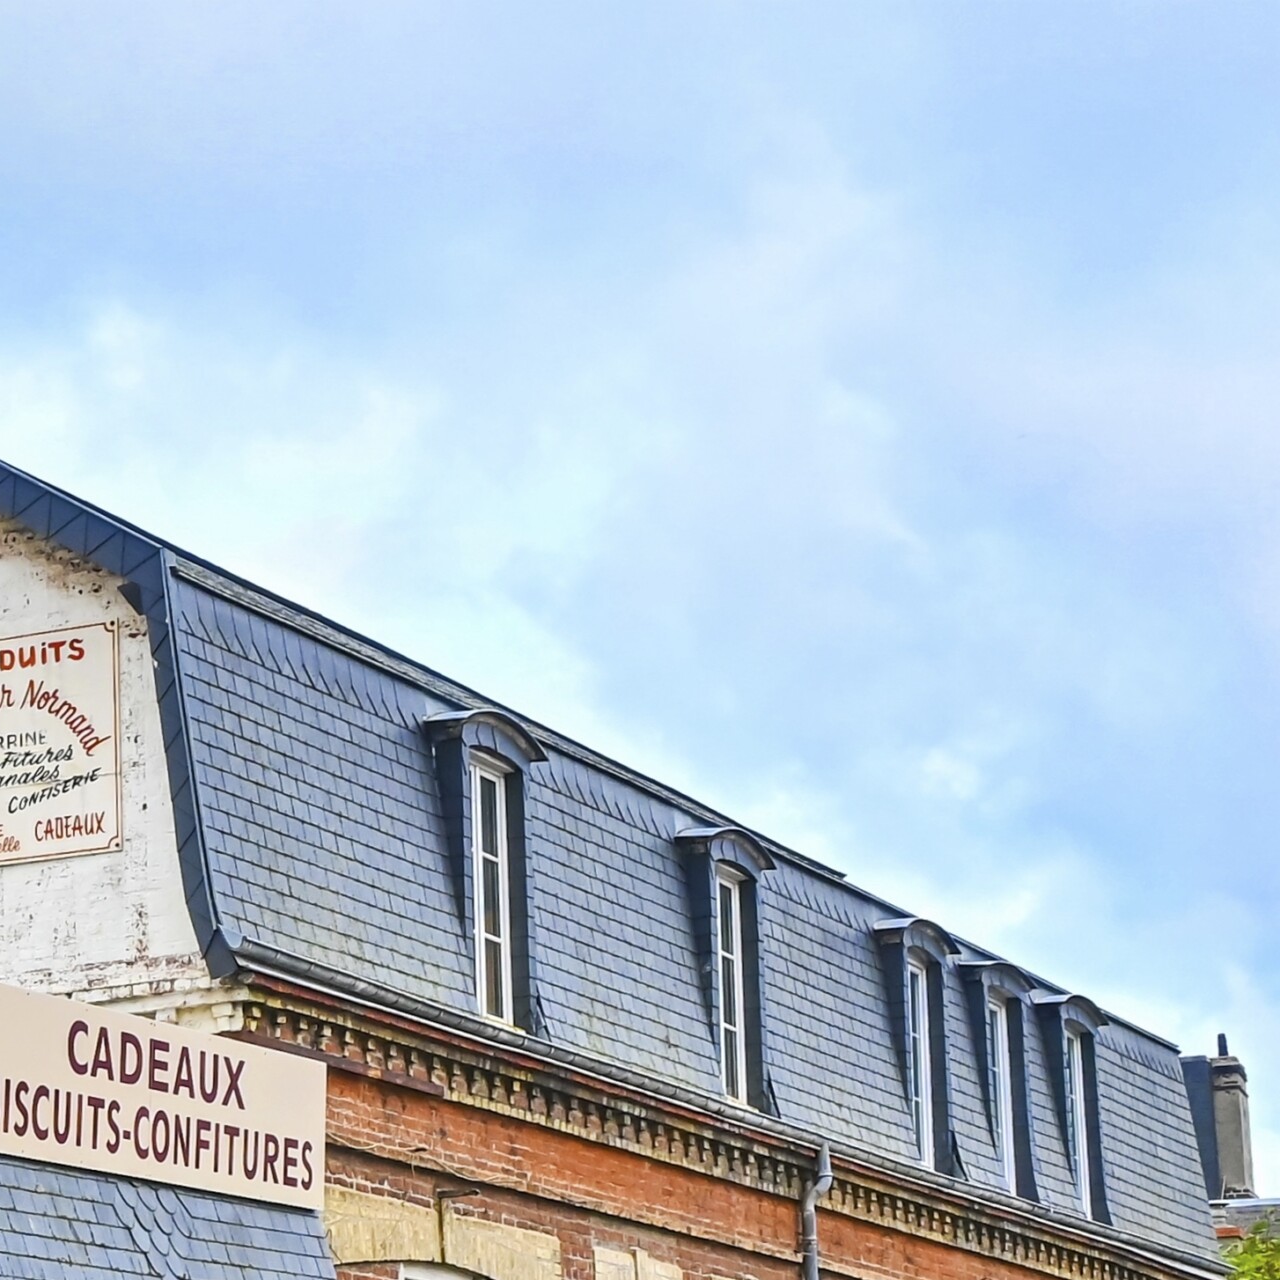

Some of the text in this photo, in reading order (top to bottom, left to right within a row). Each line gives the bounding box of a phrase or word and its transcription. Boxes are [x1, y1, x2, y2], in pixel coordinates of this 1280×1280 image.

[19, 679, 112, 757] Normand
[7, 767, 102, 814] CONFISERIE
[34, 811, 105, 842] CADEAUX
[67, 1020, 246, 1110] CADEAUX
